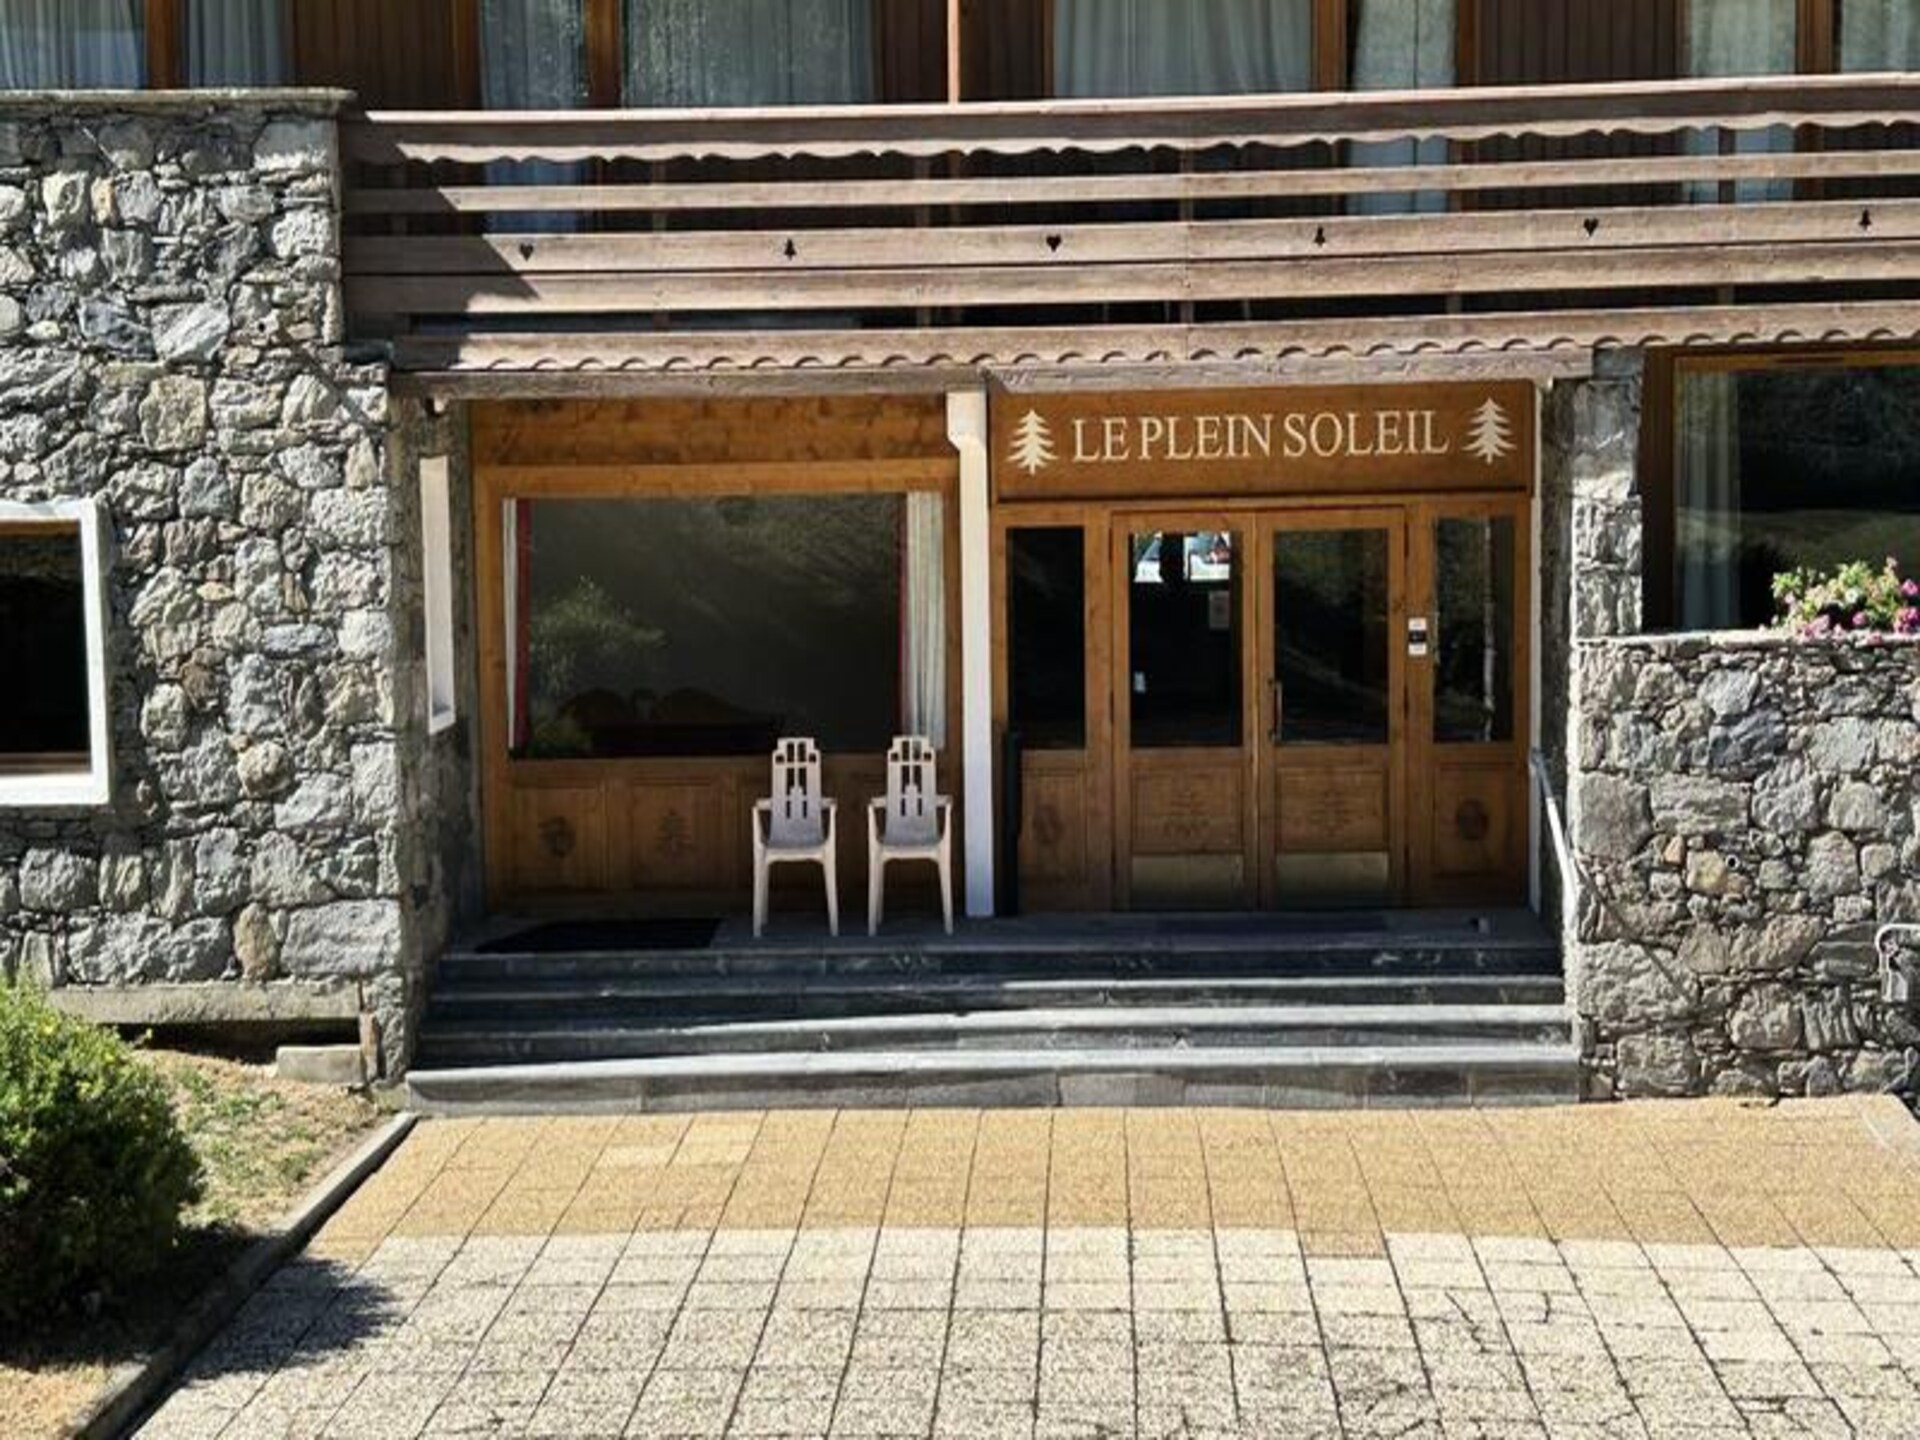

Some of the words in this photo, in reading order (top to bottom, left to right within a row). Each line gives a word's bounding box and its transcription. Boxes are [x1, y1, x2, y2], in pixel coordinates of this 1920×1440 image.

[1072, 416, 1130, 463] LE
[1139, 412, 1272, 461] PLEIN
[1283, 409, 1449, 458] SOLEIL
